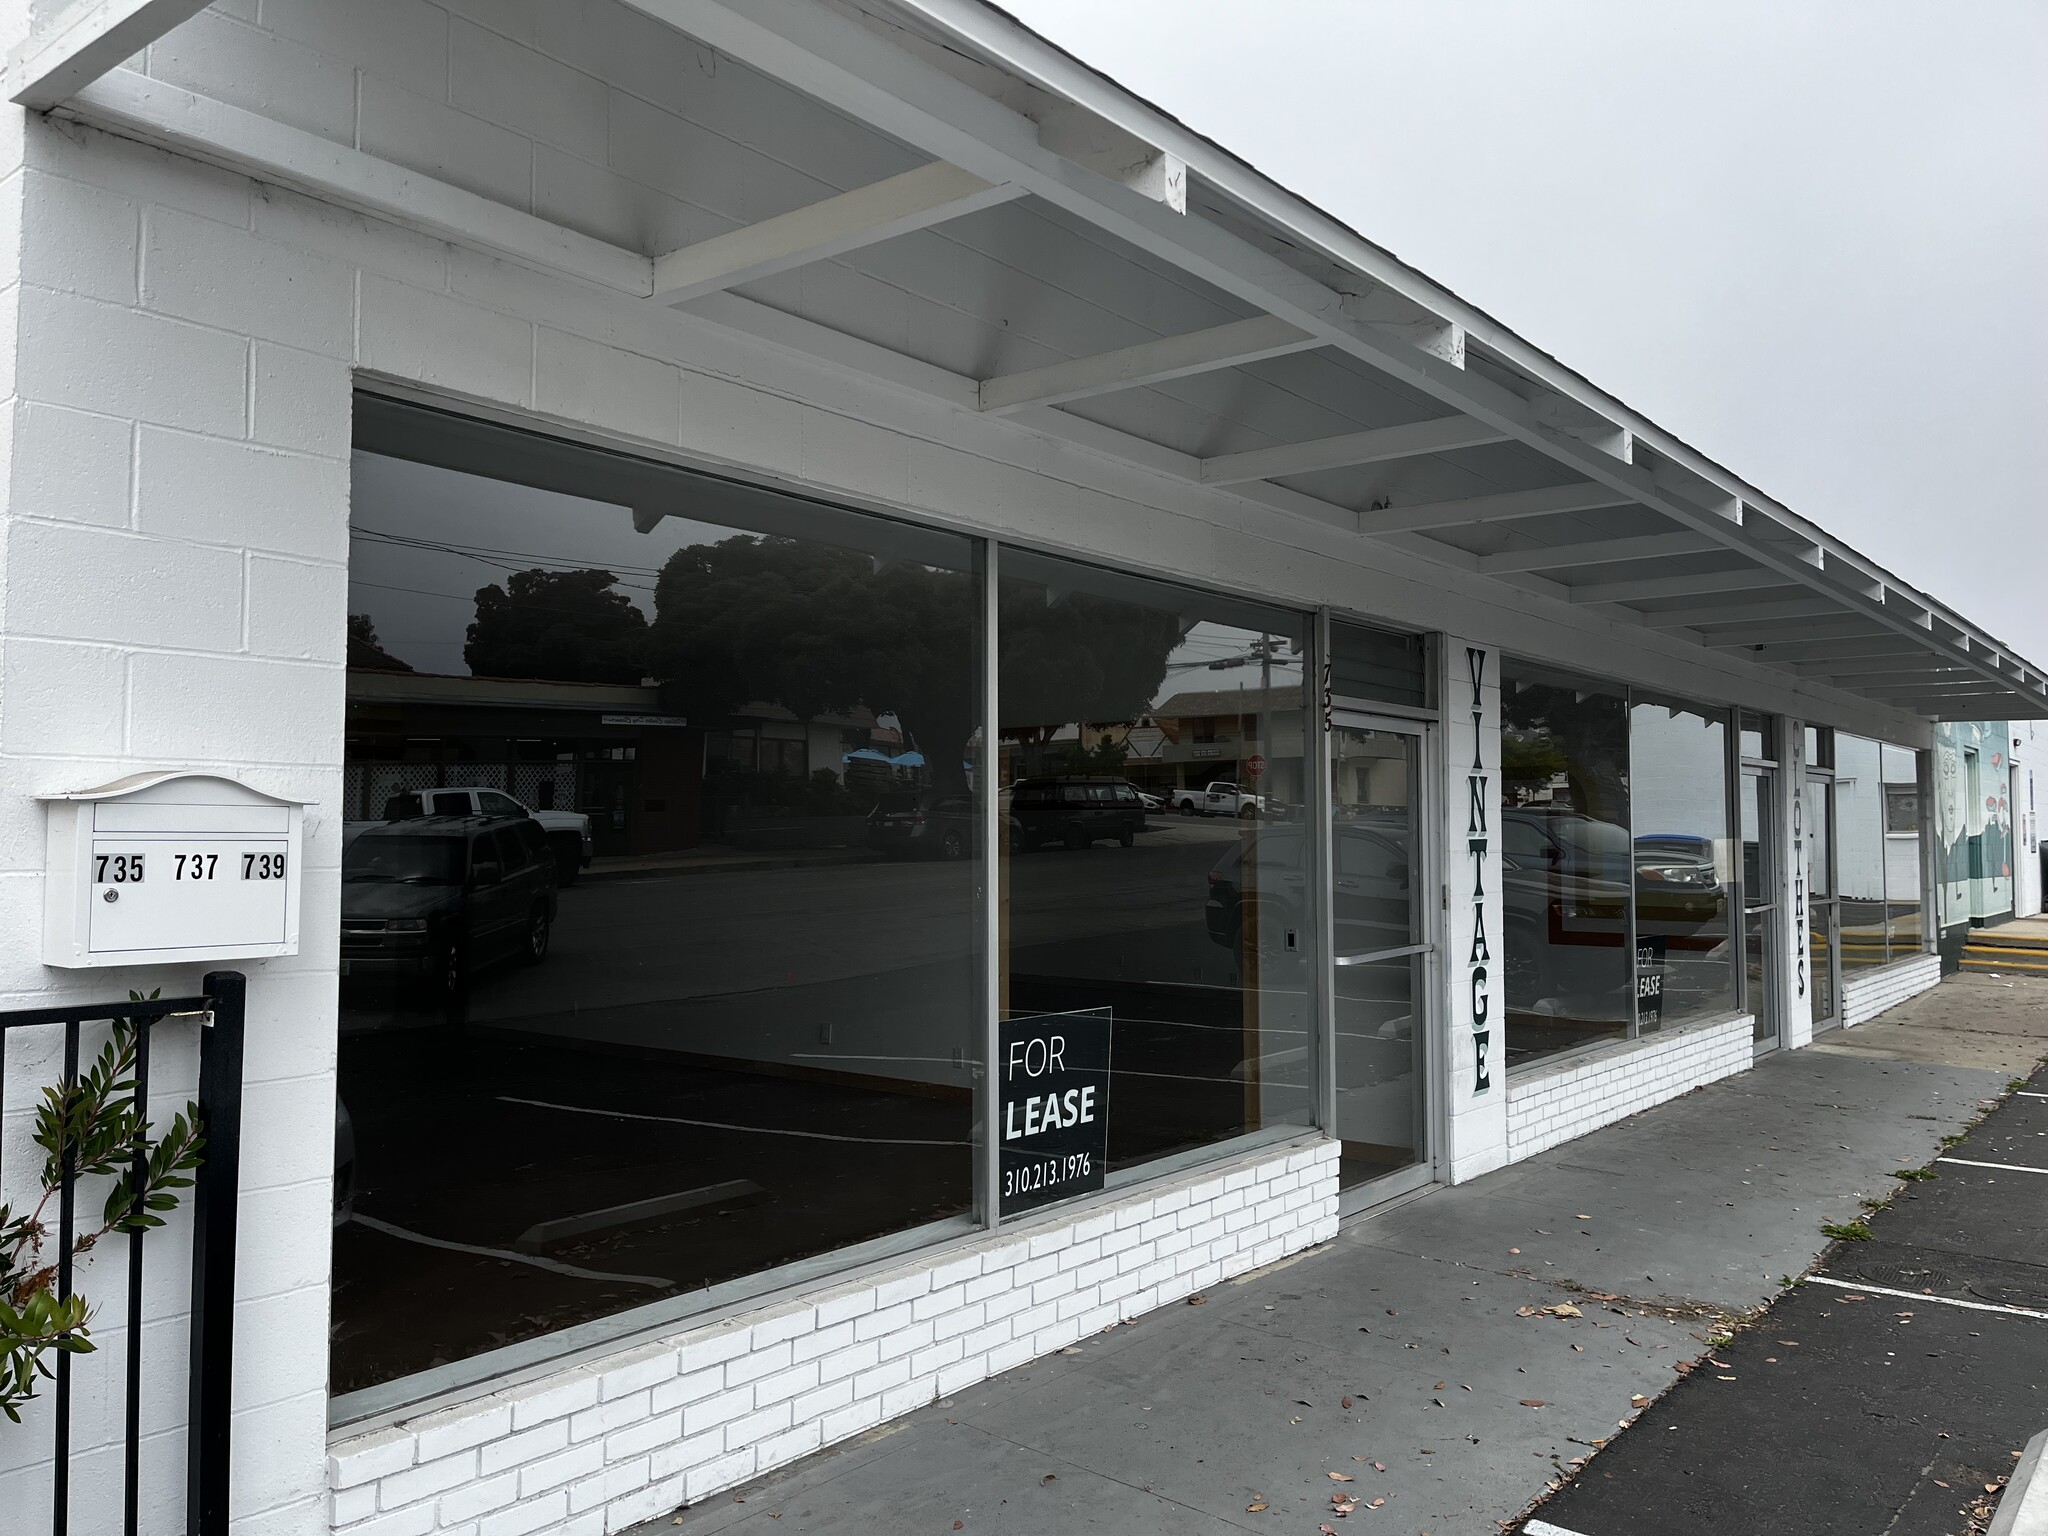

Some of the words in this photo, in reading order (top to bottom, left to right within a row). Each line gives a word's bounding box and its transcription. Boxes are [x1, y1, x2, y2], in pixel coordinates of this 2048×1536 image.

[1323, 663, 1332, 733] 735
[95, 855, 144, 883] 735
[174, 854, 219, 881] 737
[243, 853, 286, 880] 739
[1465, 647, 1490, 1097] VINTAGE
[1792, 720, 1805, 1000] CLOTHES
[1637, 946, 1654, 968] FOR
[1008, 1035, 1066, 1082] FOR
[1005, 1085, 1096, 1141] LEASE
[1004, 1152, 1091, 1197] 310.213.1976
